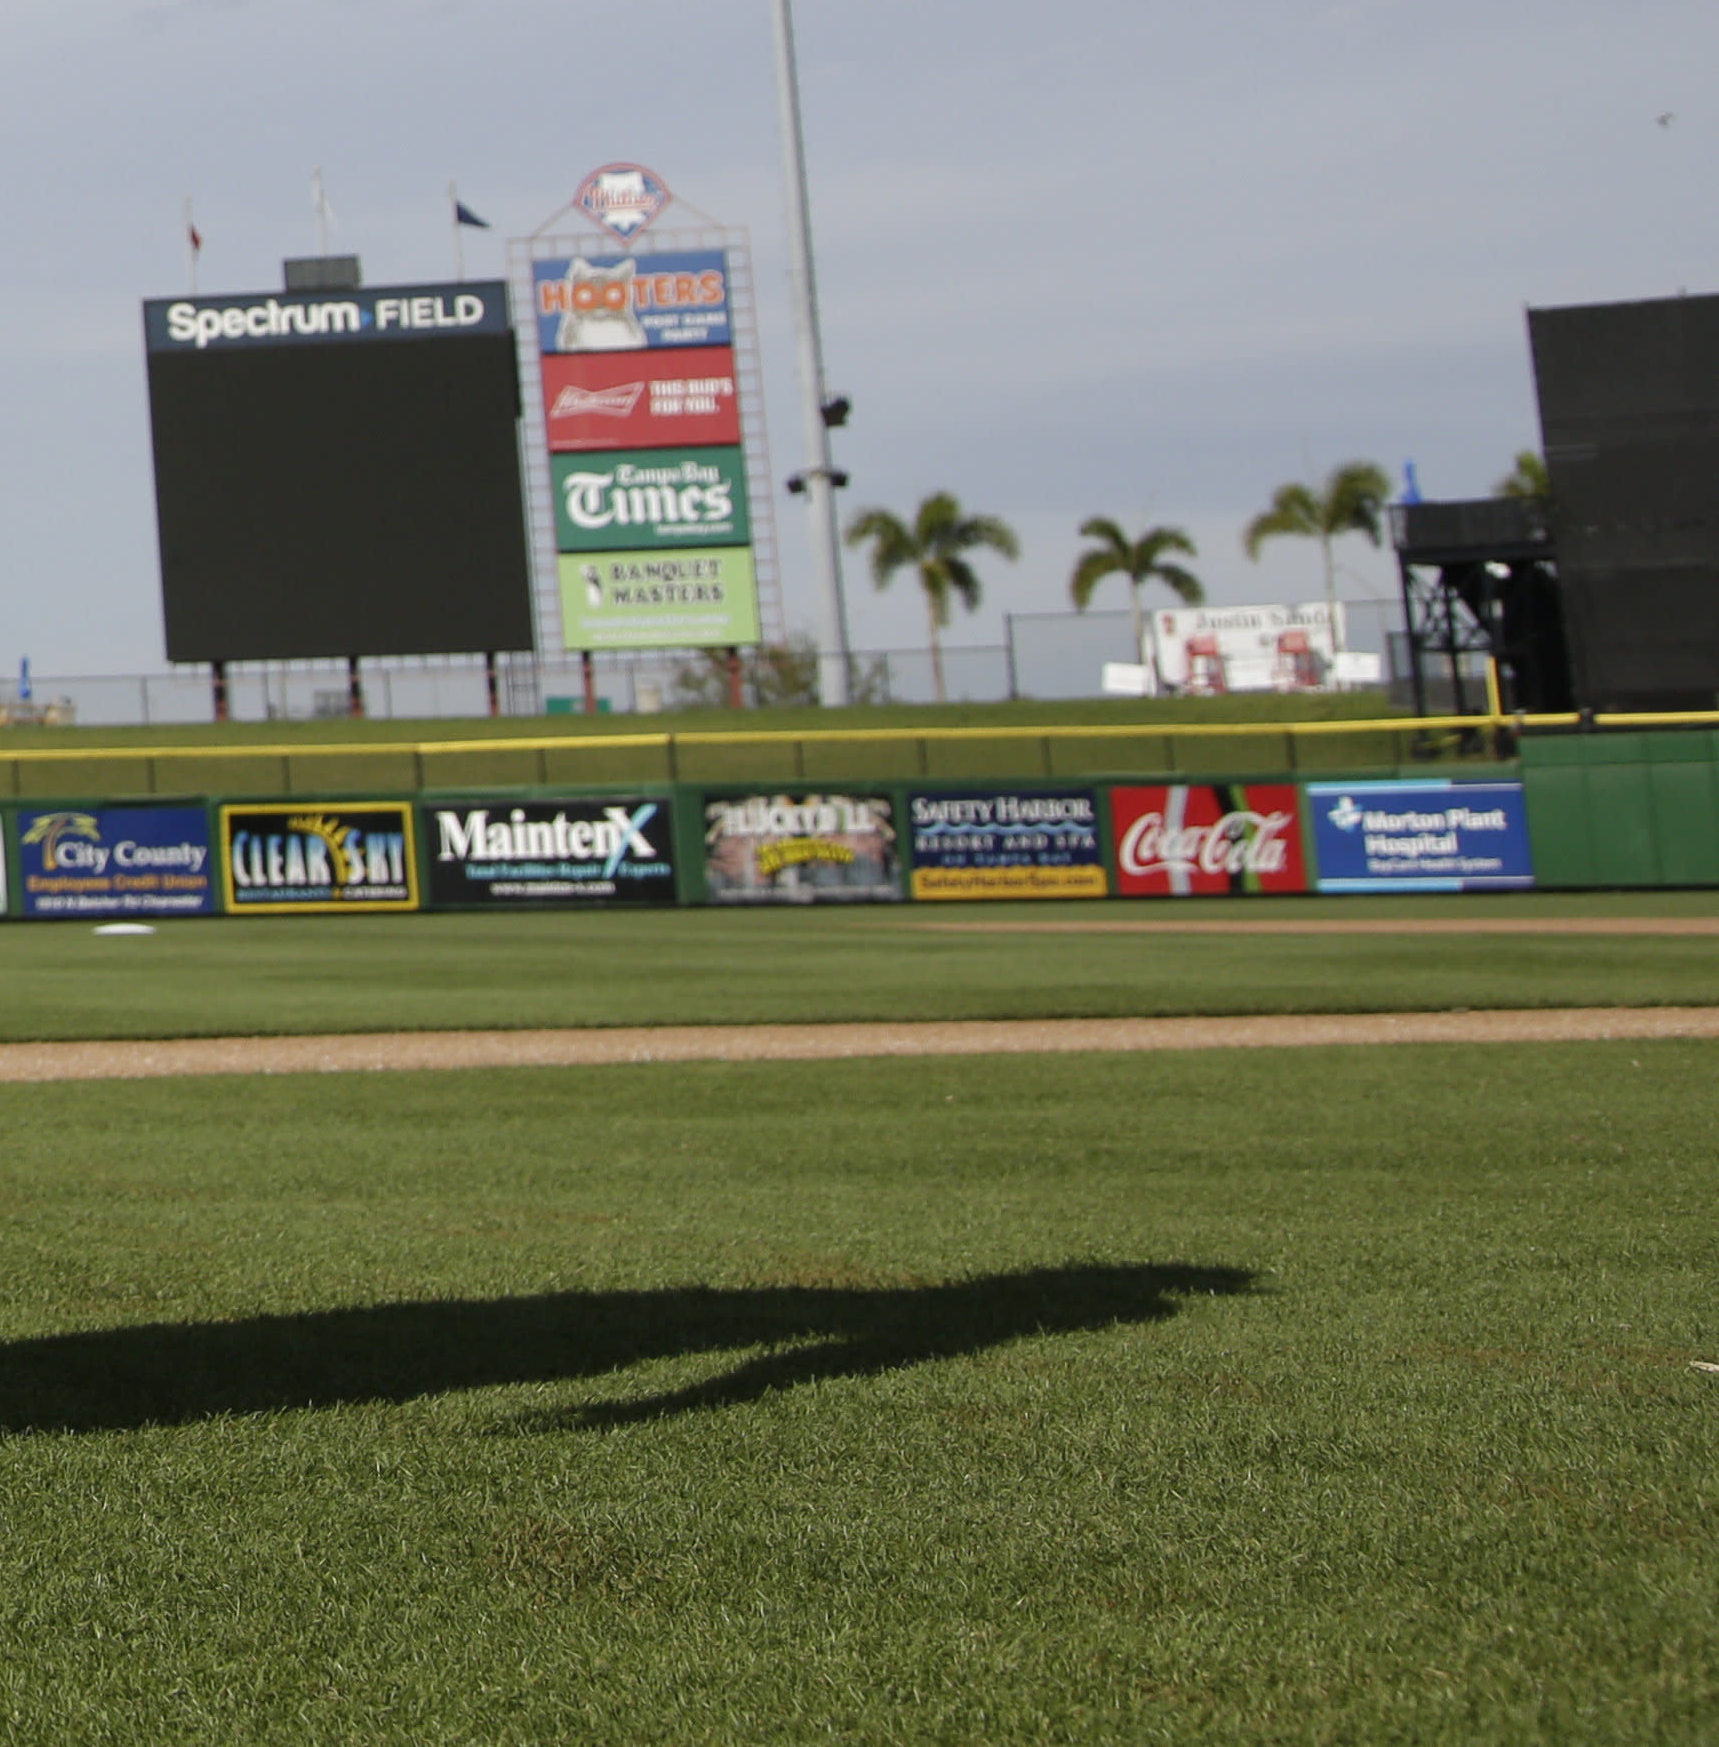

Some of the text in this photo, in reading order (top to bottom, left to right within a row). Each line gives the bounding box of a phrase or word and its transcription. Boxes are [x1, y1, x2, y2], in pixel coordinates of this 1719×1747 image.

[540, 270, 725, 314] HOOTERS
[167, 294, 485, 349] Spectrum FIELD
[650, 377, 734, 396] THIS BUD'S
[650, 397, 683, 416] FOR
[617, 461, 720, 486] Tampa Bay
[563, 472, 733, 529] Times
[611, 557, 722, 580] BANQUET
[614, 583, 724, 604] MASTERS
[912, 796, 1095, 824] SAFETY HARBOR
[1362, 807, 1508, 832] Morton Plant
[436, 805, 657, 863] MaintenX
[914, 833, 1097, 851] RESORT AND SPA
[1364, 831, 1459, 858] Hospital
[55, 840, 207, 874] City County
[232, 828, 405, 887] CLEAR SKY
[114, 872, 160, 890] Credit
[163, 873, 208, 890] Union
